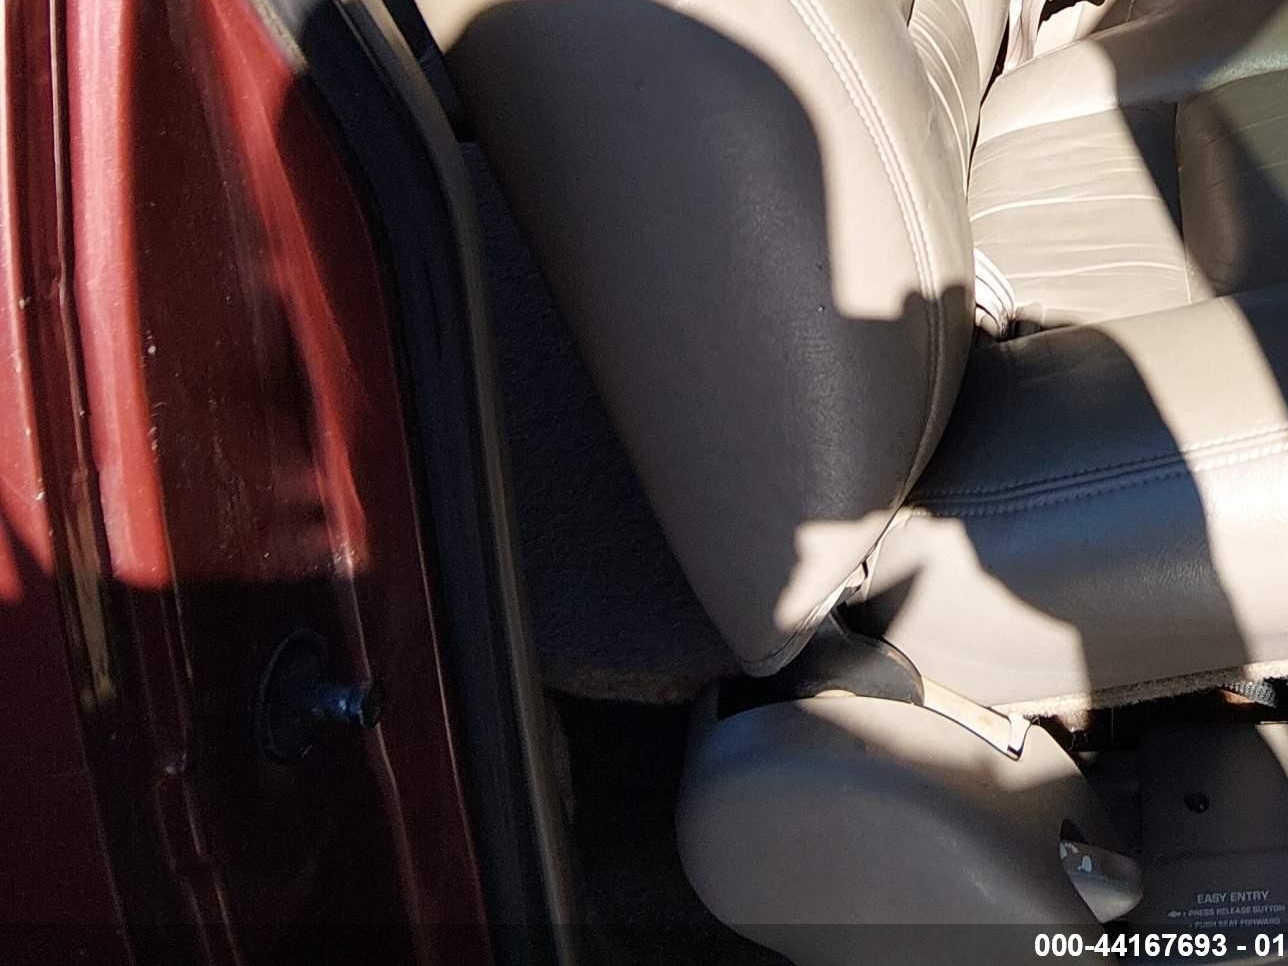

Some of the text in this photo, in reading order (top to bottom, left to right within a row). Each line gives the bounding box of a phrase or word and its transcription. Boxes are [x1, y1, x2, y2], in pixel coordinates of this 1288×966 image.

[1197, 890, 1269, 904] EASY ENTRY
[1216, 905, 1250, 915] RELEASE
